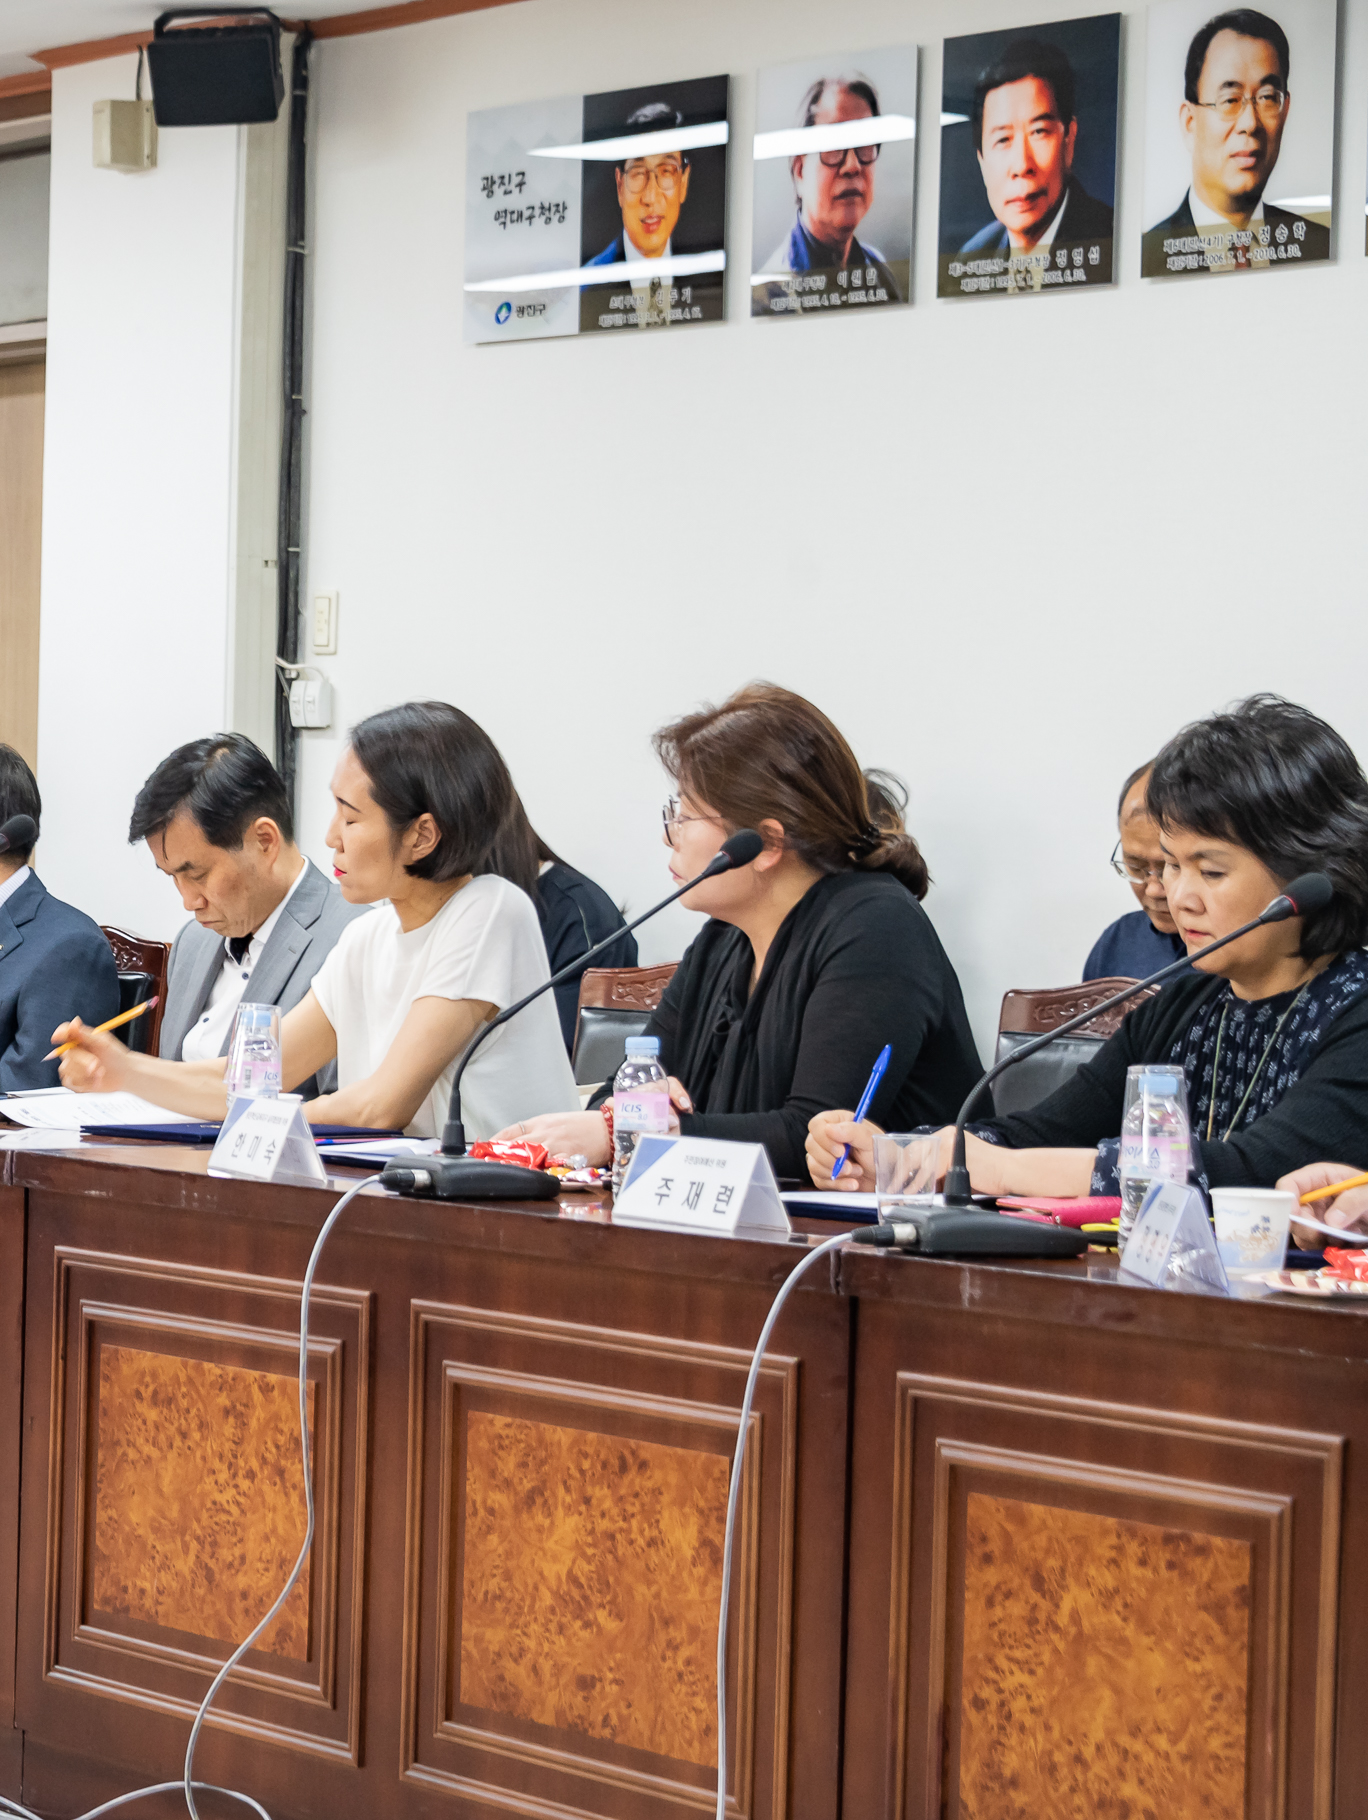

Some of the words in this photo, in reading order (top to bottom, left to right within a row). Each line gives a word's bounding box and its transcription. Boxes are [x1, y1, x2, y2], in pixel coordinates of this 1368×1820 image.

[480, 171, 527, 198] 광진구
[493, 201, 568, 230] 역대구청장
[1259, 221, 1307, 245] 정송학
[515, 303, 547, 319] 광진구
[231, 1132, 277, 1165] 한미숙
[655, 1177, 735, 1215] 주재련
